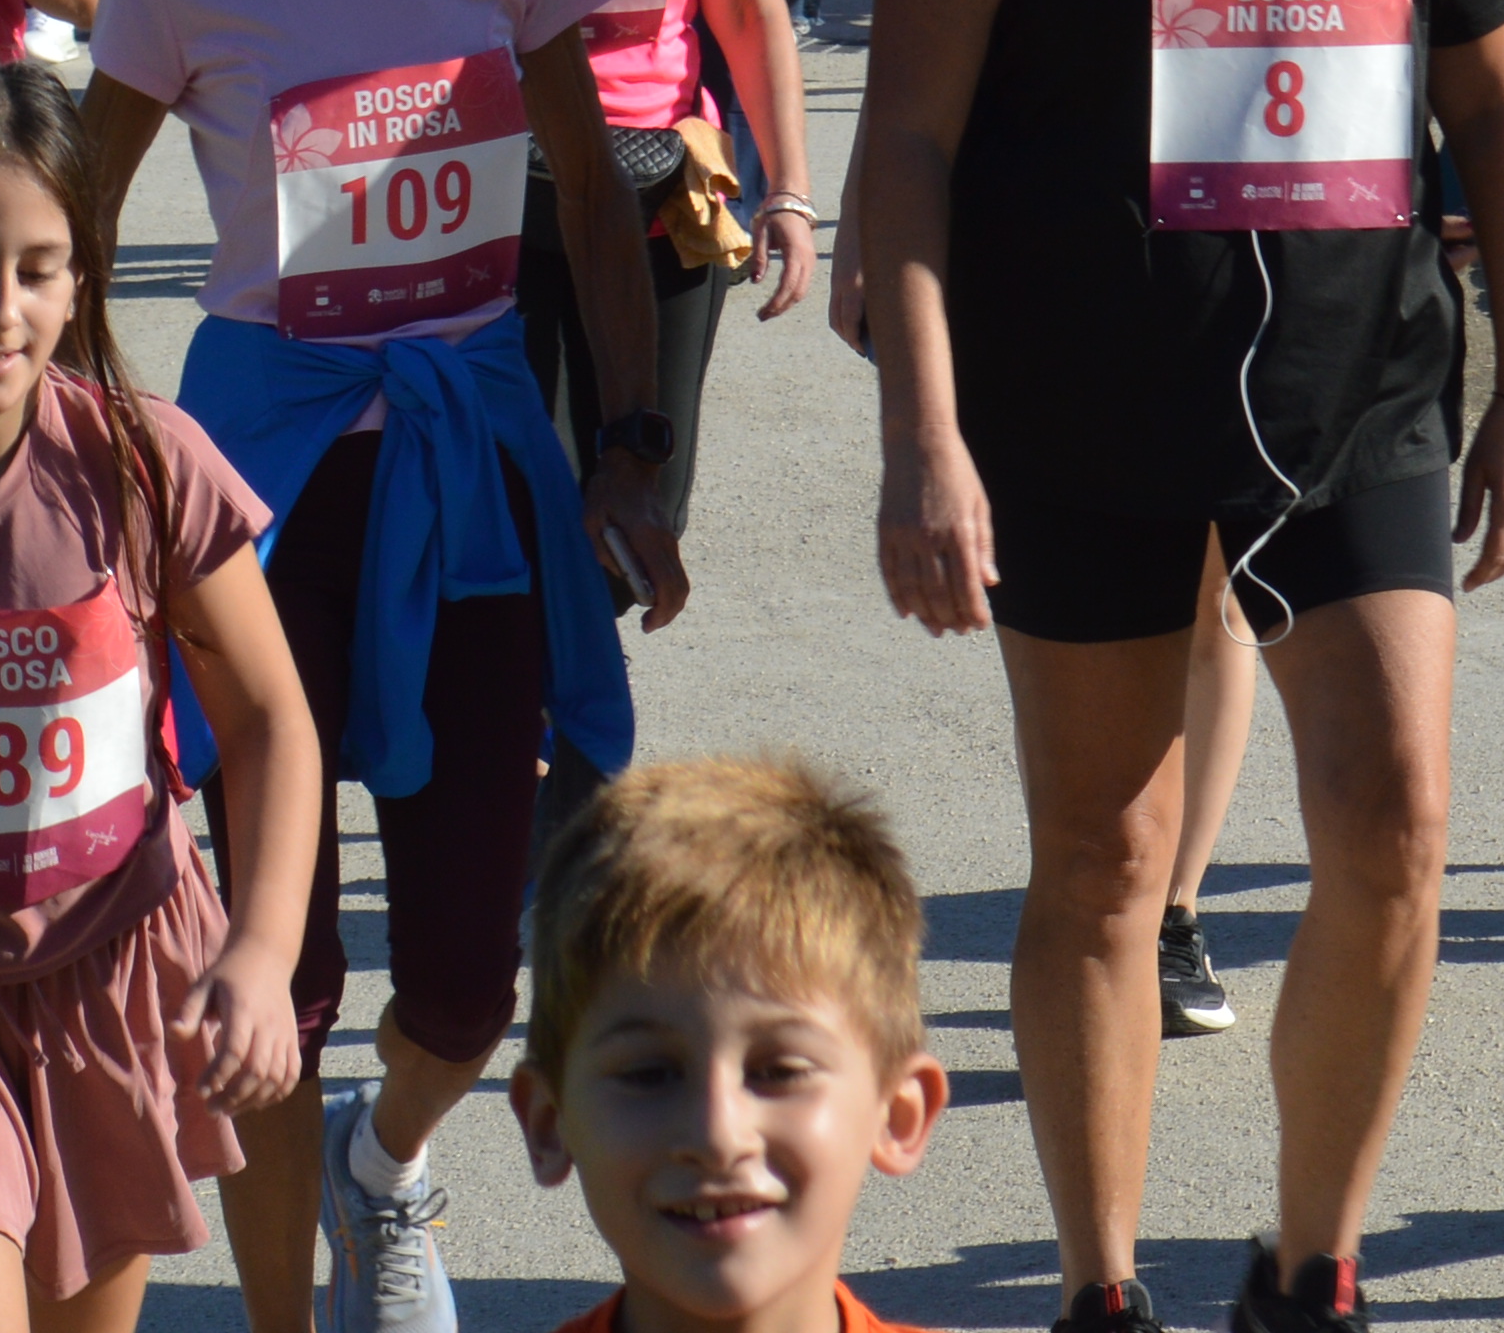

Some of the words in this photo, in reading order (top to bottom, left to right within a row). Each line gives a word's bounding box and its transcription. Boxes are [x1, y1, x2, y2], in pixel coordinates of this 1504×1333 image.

[1227, 6, 1258, 33] IN
[1265, 5, 1345, 33] ROSA
[354, 78, 452, 118] BOSCO
[1263, 60, 1305, 138] 8
[347, 119, 378, 150] IN
[386, 107, 463, 146] ROSA
[340, 160, 473, 246] 109
